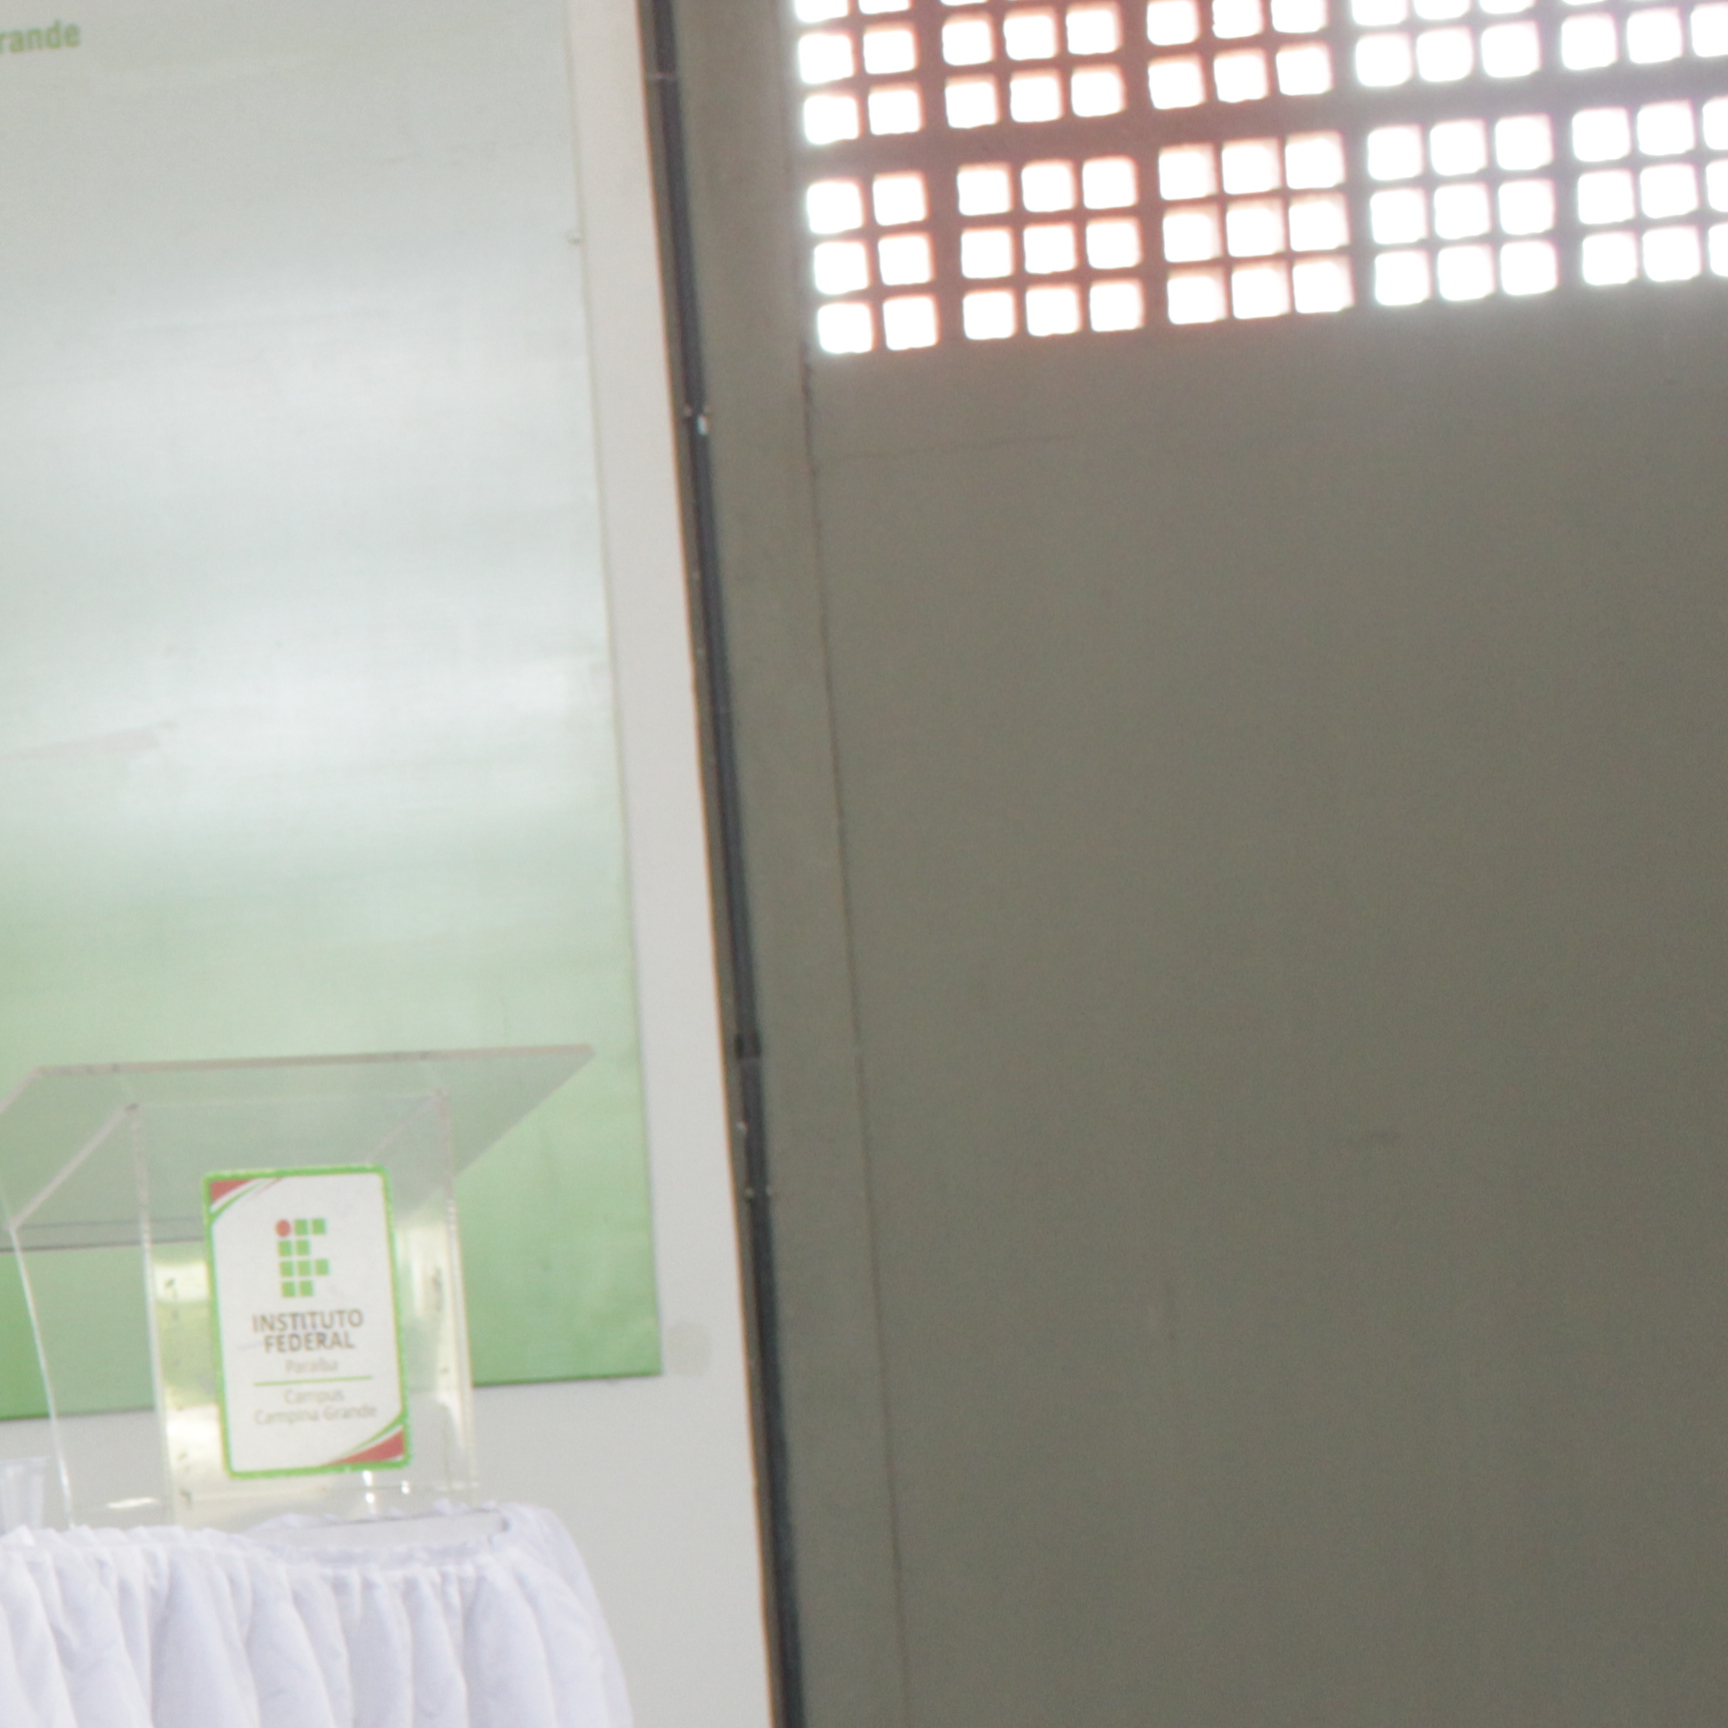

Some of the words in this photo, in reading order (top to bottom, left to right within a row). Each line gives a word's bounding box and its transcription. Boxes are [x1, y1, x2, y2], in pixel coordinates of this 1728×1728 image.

[252, 1308, 364, 1333] INSTITUTO
[264, 1331, 356, 1353] FEDERAL
[284, 1388, 345, 1405] Campus
[253, 1408, 320, 1425] Campina
[322, 1403, 378, 1421] Grande
